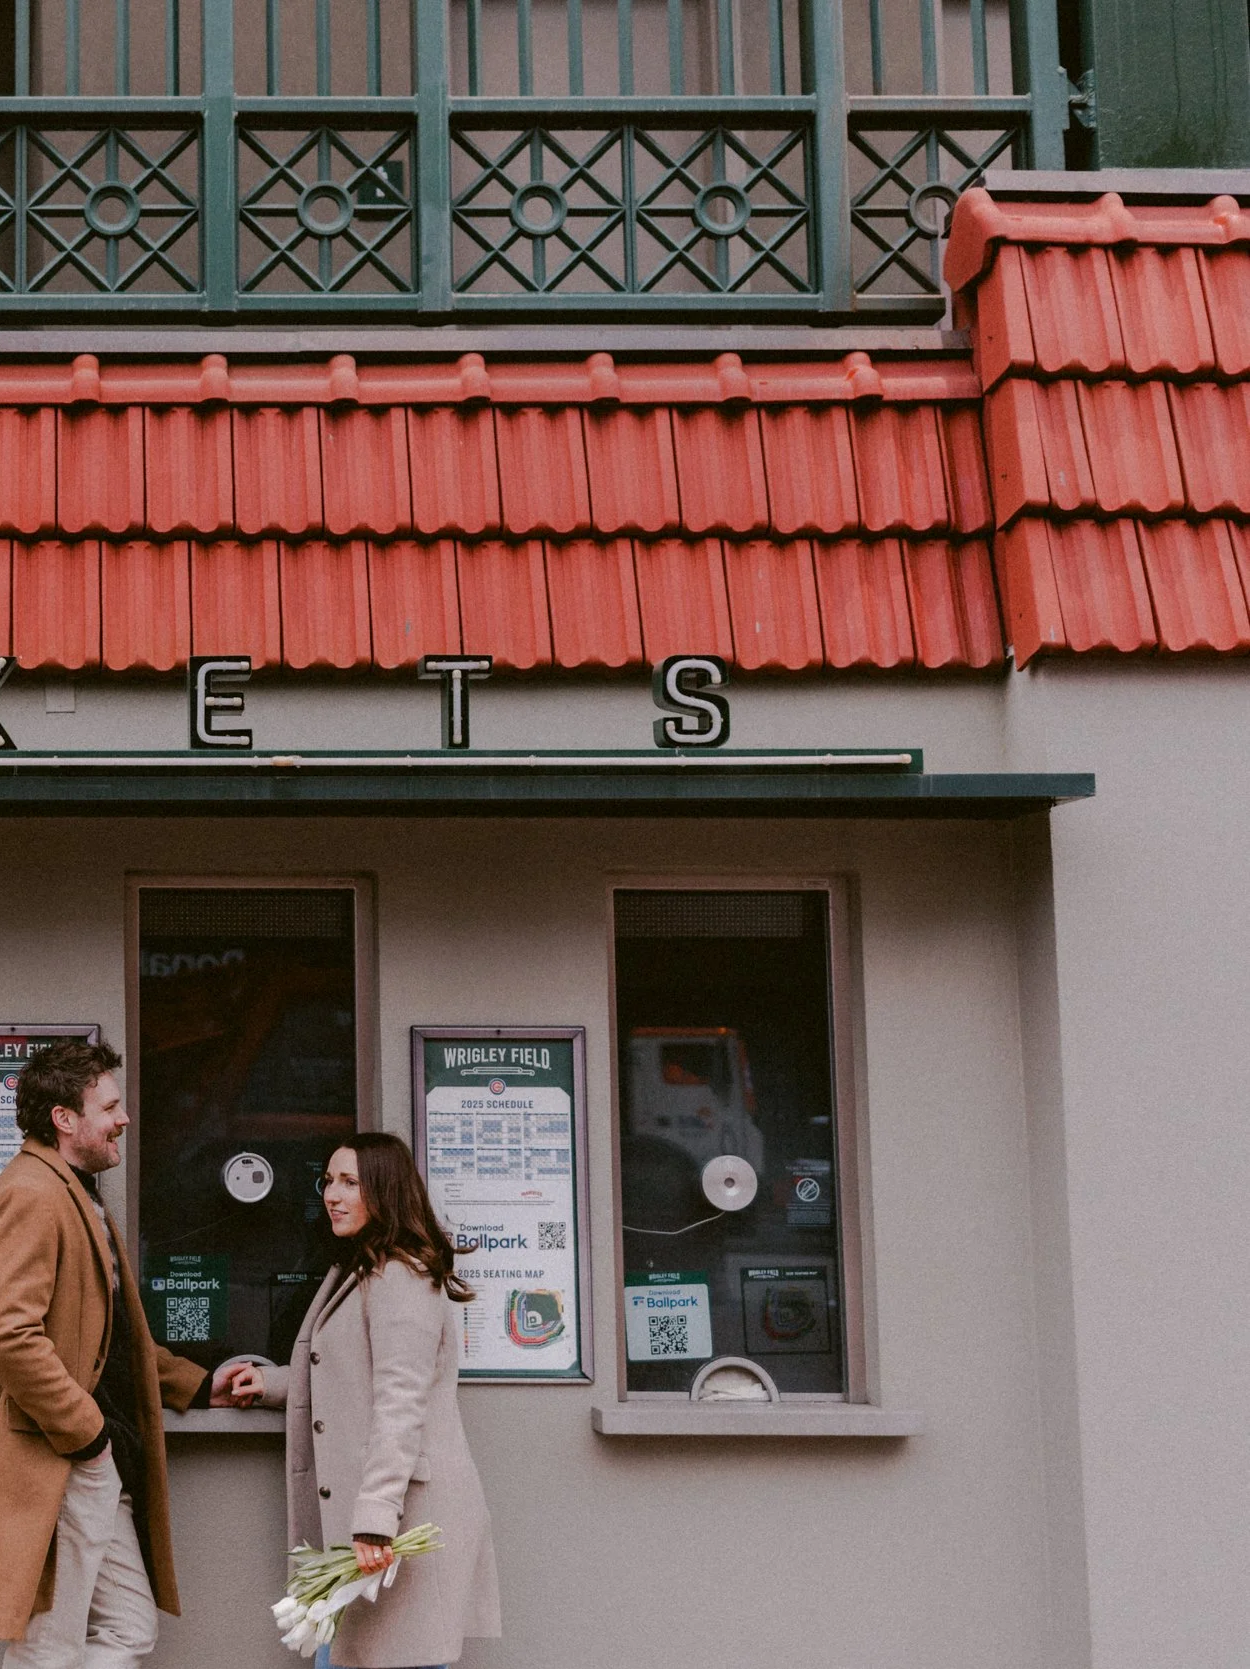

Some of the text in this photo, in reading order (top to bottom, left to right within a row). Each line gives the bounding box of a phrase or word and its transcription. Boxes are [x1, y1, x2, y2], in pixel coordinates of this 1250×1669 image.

[443, 1047, 506, 1069] WRIGLEY
[461, 1100, 534, 1109] 2025 SCHEDULE
[460, 1223, 504, 1232] Download
[456, 1234, 528, 1252] Ballpark
[458, 1269, 545, 1278] 2025 SEATING MAP
[167, 1278, 220, 1292] Ballpark
[647, 1296, 698, 1310] Ballpark
